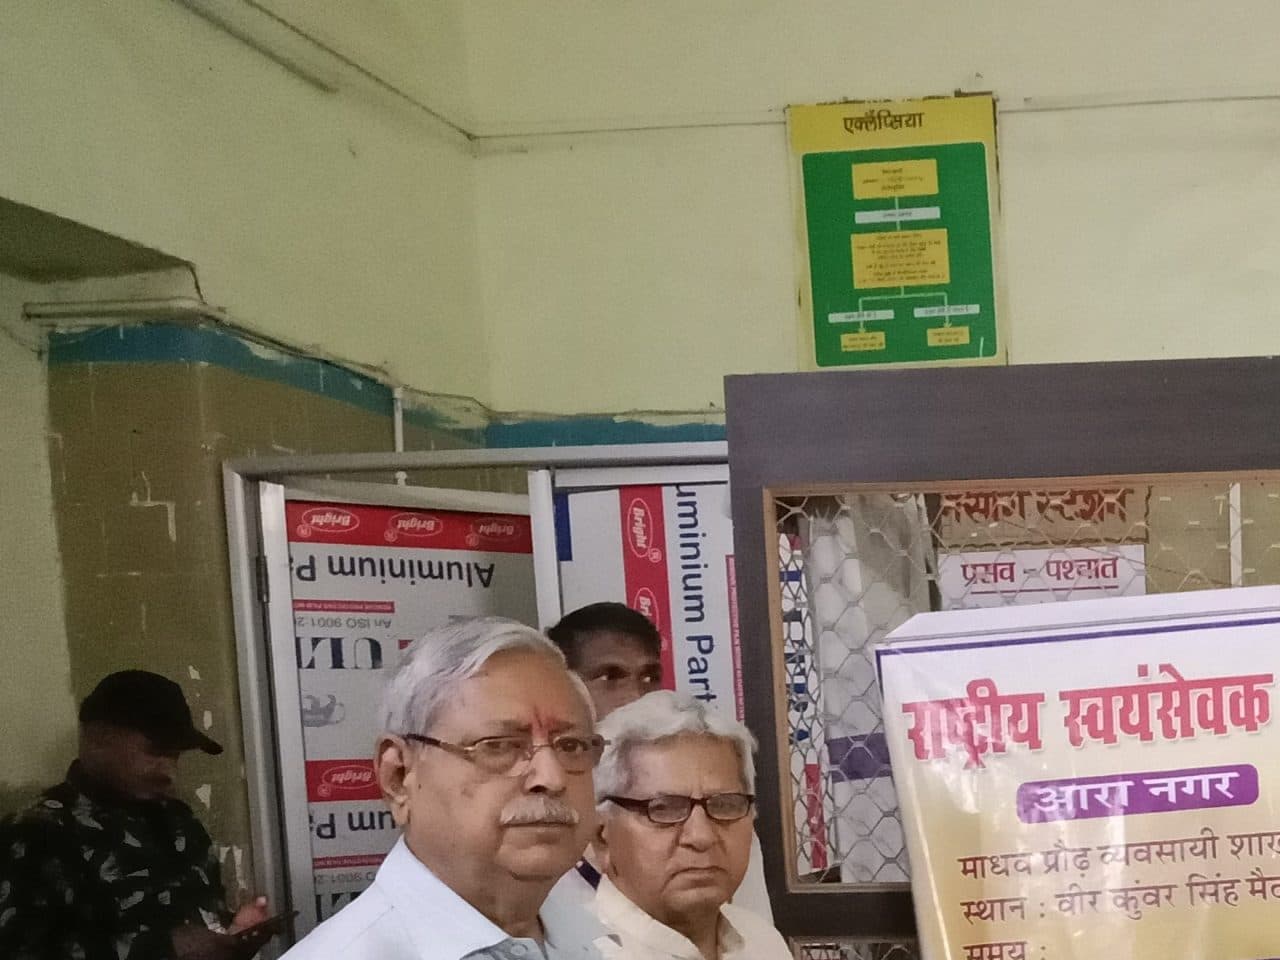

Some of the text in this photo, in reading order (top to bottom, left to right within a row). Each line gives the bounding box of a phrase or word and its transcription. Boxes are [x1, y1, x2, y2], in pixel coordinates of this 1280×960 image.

[311, 512, 352, 528] Bright
[397, 517, 437, 532] Bright
[631, 506, 648, 550] Bright
[327, 555, 495, 589] Aluminium
[961, 561, 1016, 587] प्रसव
[675, 484, 717, 703] uminium Part
[345, 617, 372, 630] ISO
[902, 677, 1046, 770] राष्ट्रीय
[1059, 663, 1274, 747] स्वयंसेवक
[1034, 772, 1240, 812] आरा नगर
[957, 852, 1032, 879] माधव
[1097, 826, 1219, 867] व्यवसायी
[960, 897, 1027, 925] स्थान
[1054, 883, 1102, 915] वीर
[1108, 879, 1178, 920] कुंवर
[1186, 872, 1241, 906] सिंह
